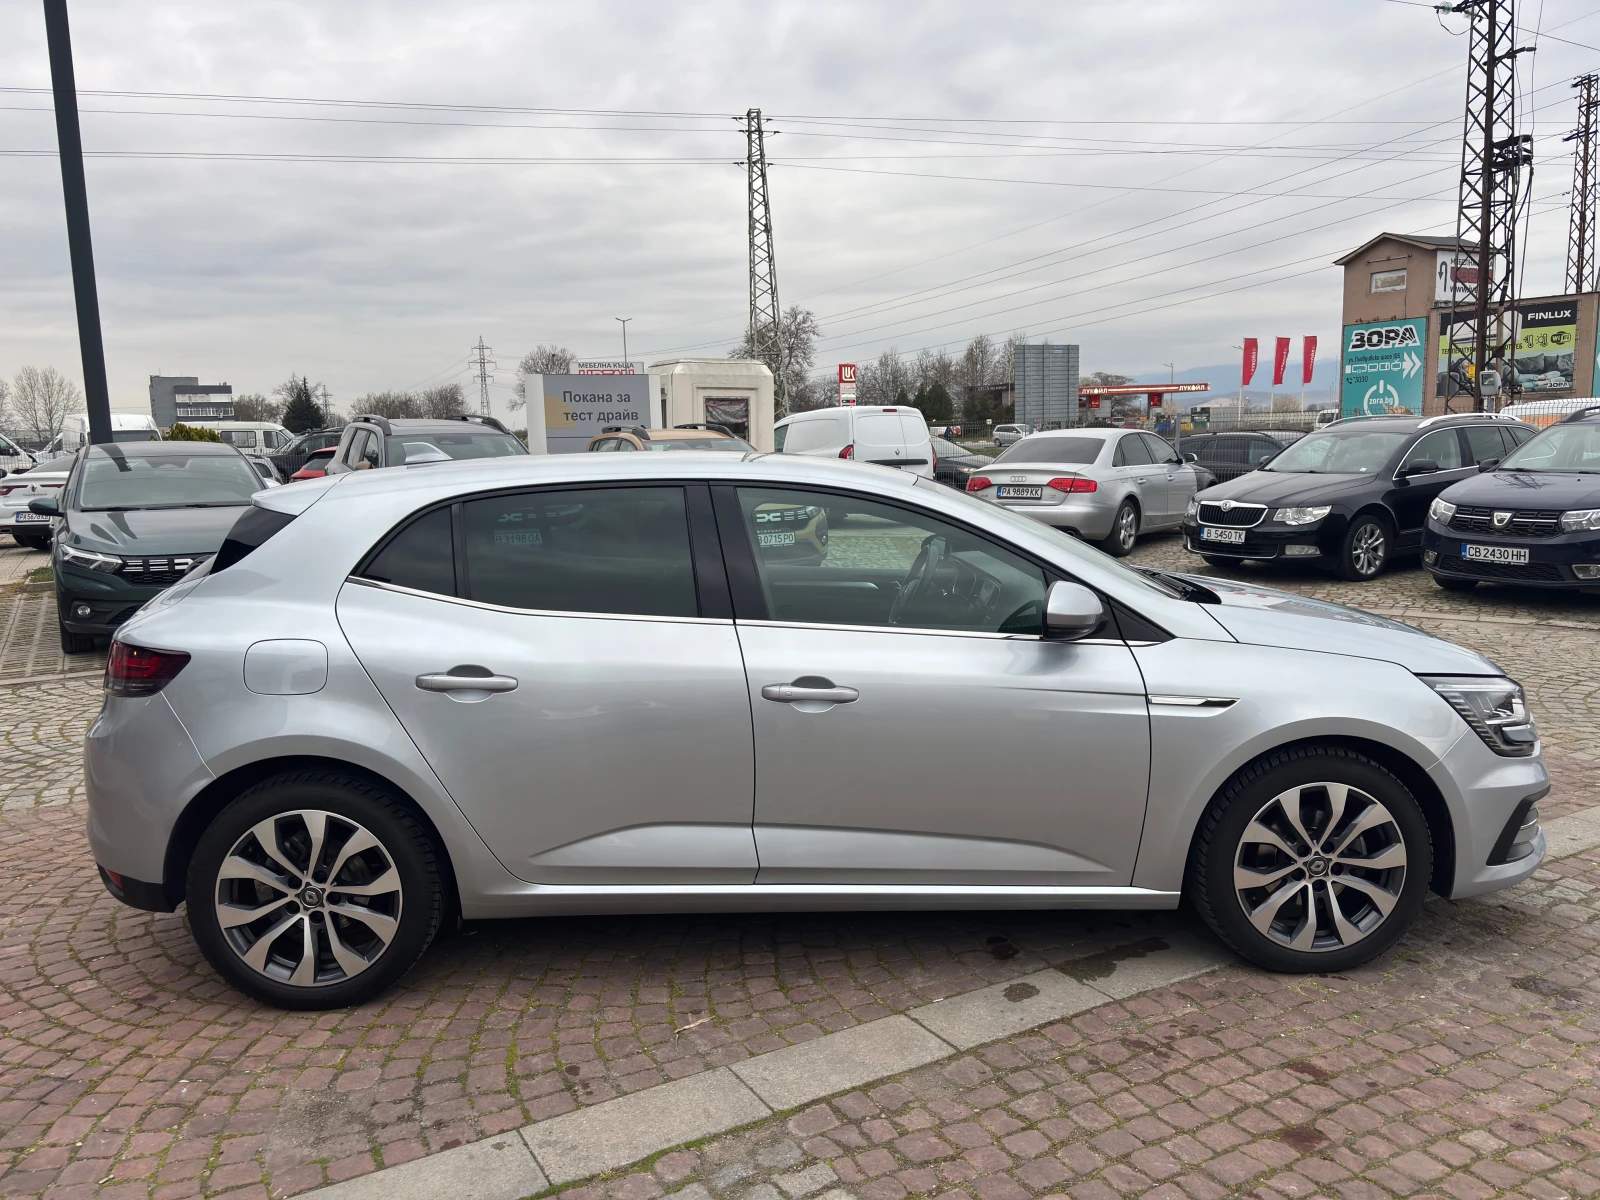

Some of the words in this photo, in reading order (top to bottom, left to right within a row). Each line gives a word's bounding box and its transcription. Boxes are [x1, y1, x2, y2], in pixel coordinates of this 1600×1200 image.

[1527, 309, 1571, 320] FINLUX
[1348, 325, 1420, 352] ЗОРА
[563, 391, 612, 403] Покана
[616, 393, 631, 403] за
[1369, 396, 1393, 405] zora.bg
[563, 411, 593, 421] тест
[597, 408, 639, 423] драйв
[1001, 487, 1011, 496] PA
[1012, 487, 1029, 497] 9889
[1029, 488, 1040, 497] KK
[763, 534, 783, 544] 0715
[1206, 528, 1212, 538] B
[1214, 529, 1233, 540] 5450
[1234, 531, 1244, 541] TK
[1468, 546, 1481, 557] CB
[1483, 547, 1509, 560] 2430
[1511, 549, 1527, 561] HH
